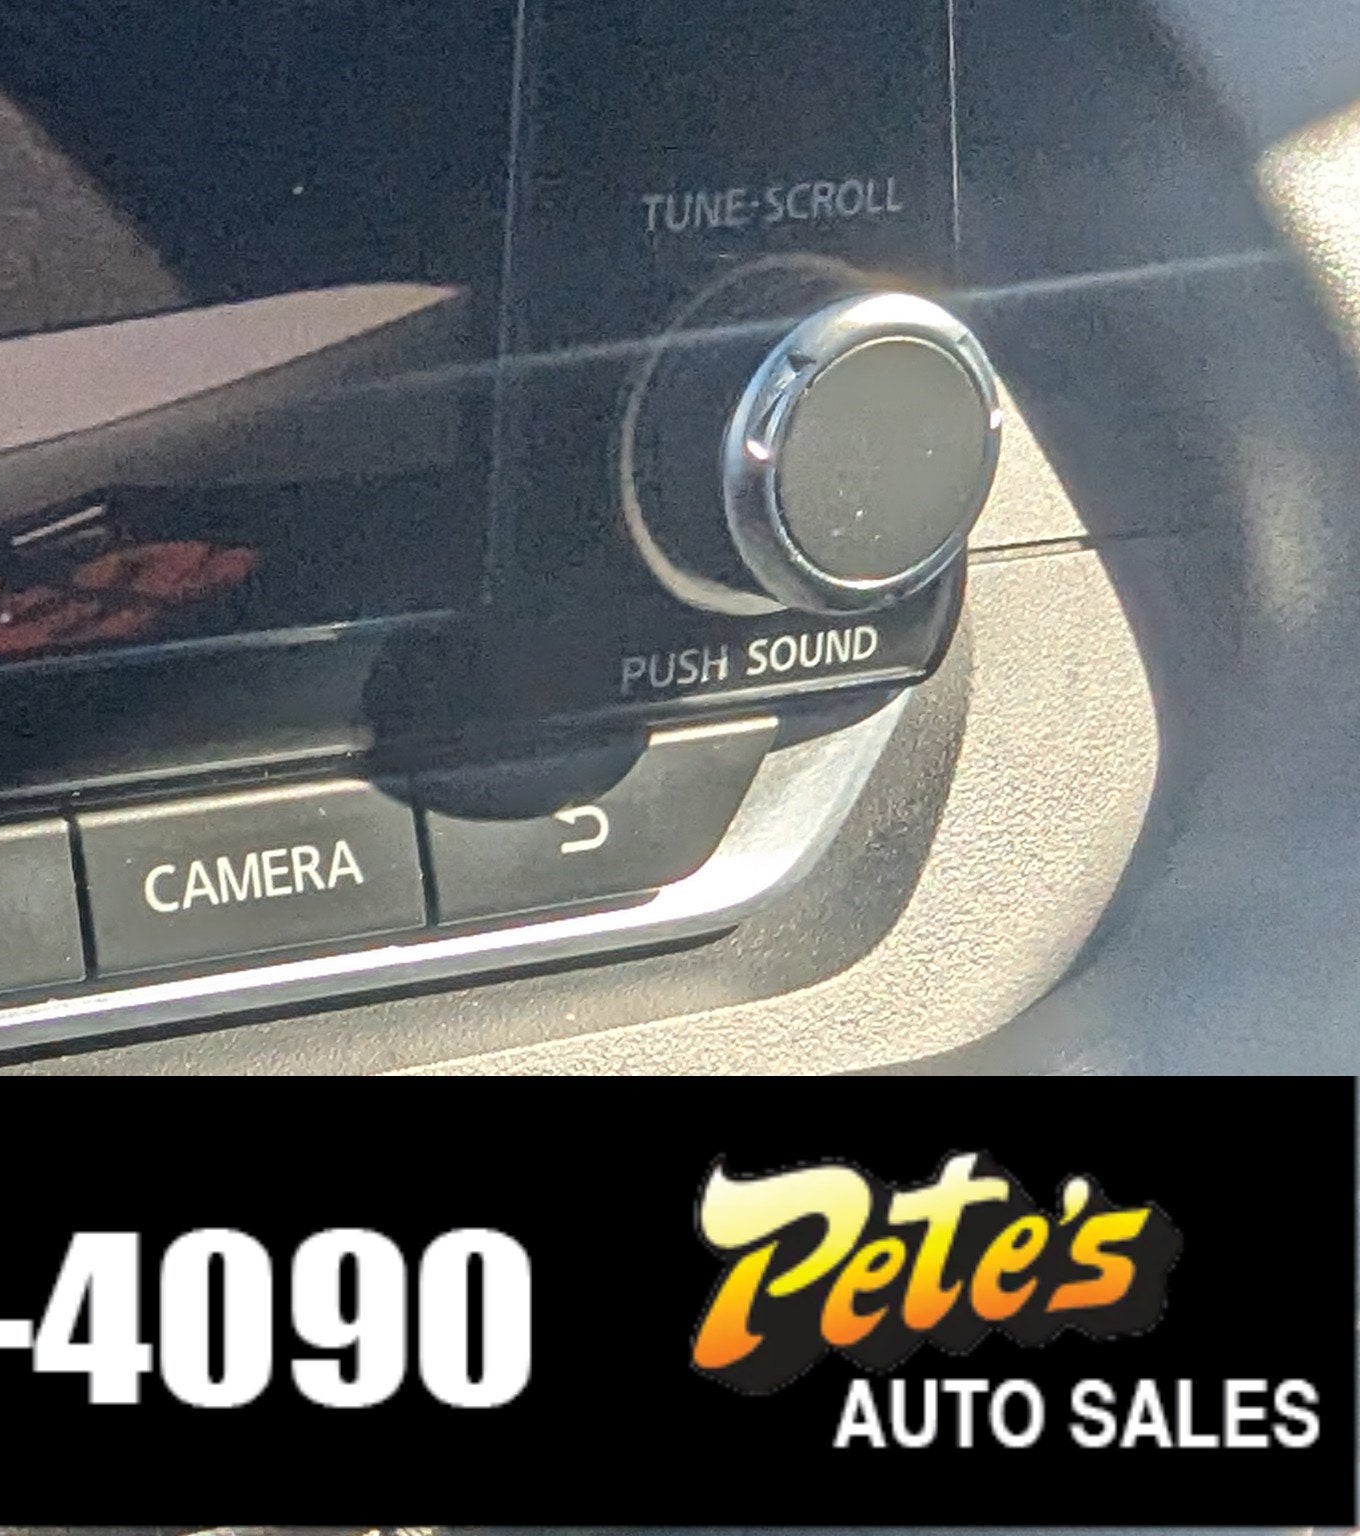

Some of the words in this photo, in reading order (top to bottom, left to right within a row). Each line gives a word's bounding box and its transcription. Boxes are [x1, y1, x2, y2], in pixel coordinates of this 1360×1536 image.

[619, 644, 729, 696] PUSH
[745, 624, 879, 676] SOUND
[144, 839, 364, 913] CAMERA
